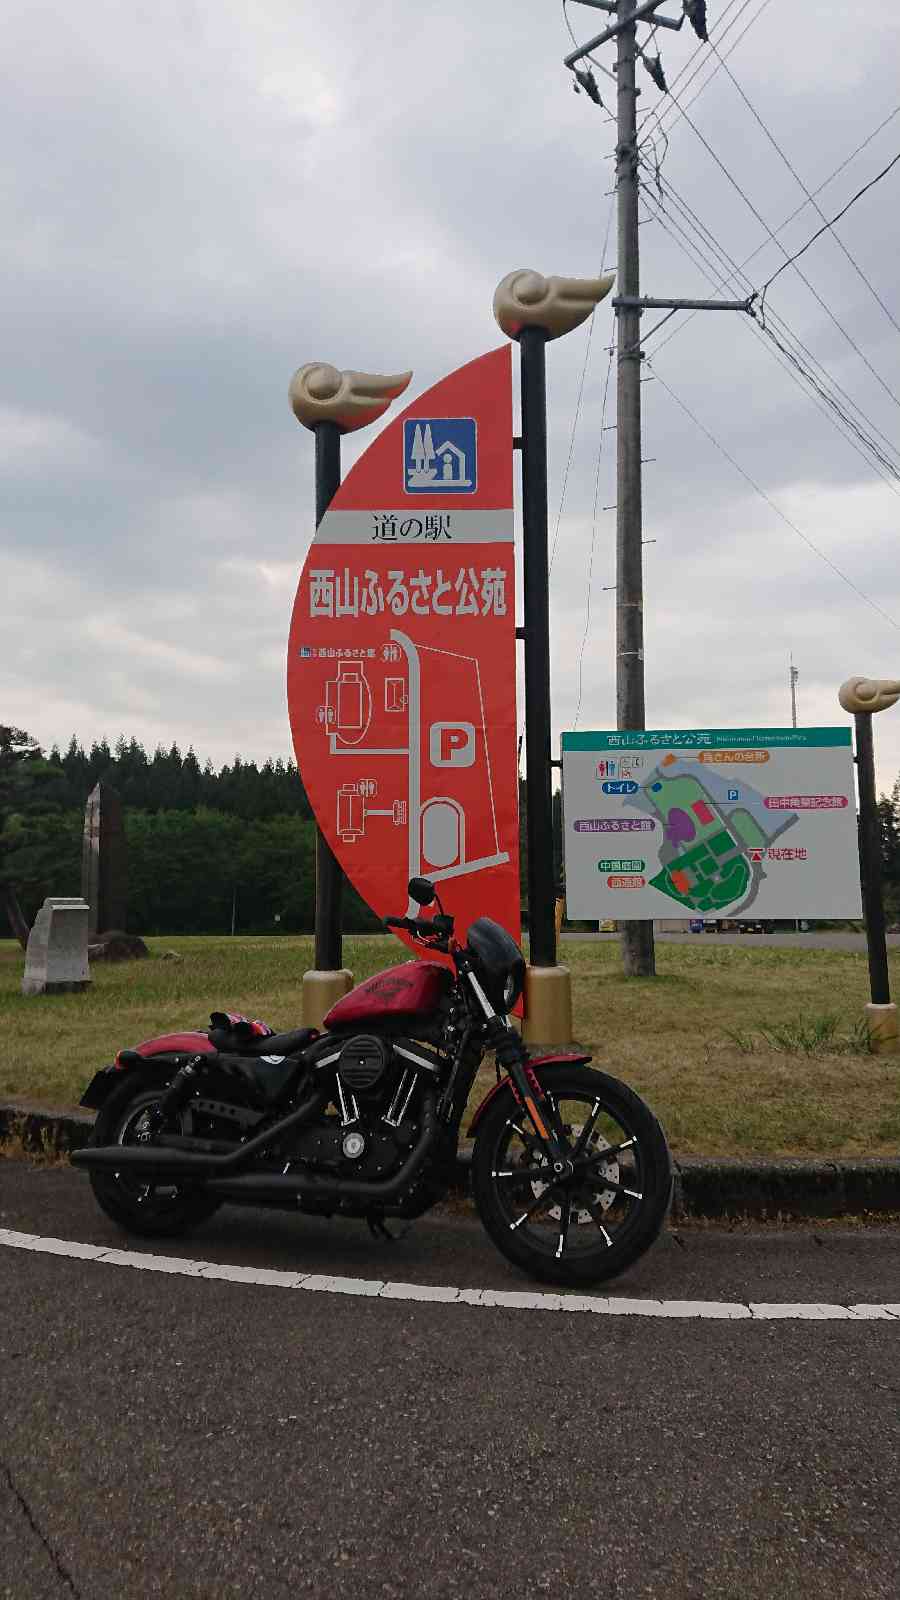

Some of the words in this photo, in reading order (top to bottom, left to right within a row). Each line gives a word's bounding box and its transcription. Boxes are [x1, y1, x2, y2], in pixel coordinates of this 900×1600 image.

[372, 514, 452, 541] 道の駅
[308, 567, 508, 618] 西山ふるさと公苑
[441, 729, 469, 761] P
[608, 783, 636, 793] トイレ
[767, 847, 808, 861] 現在地
